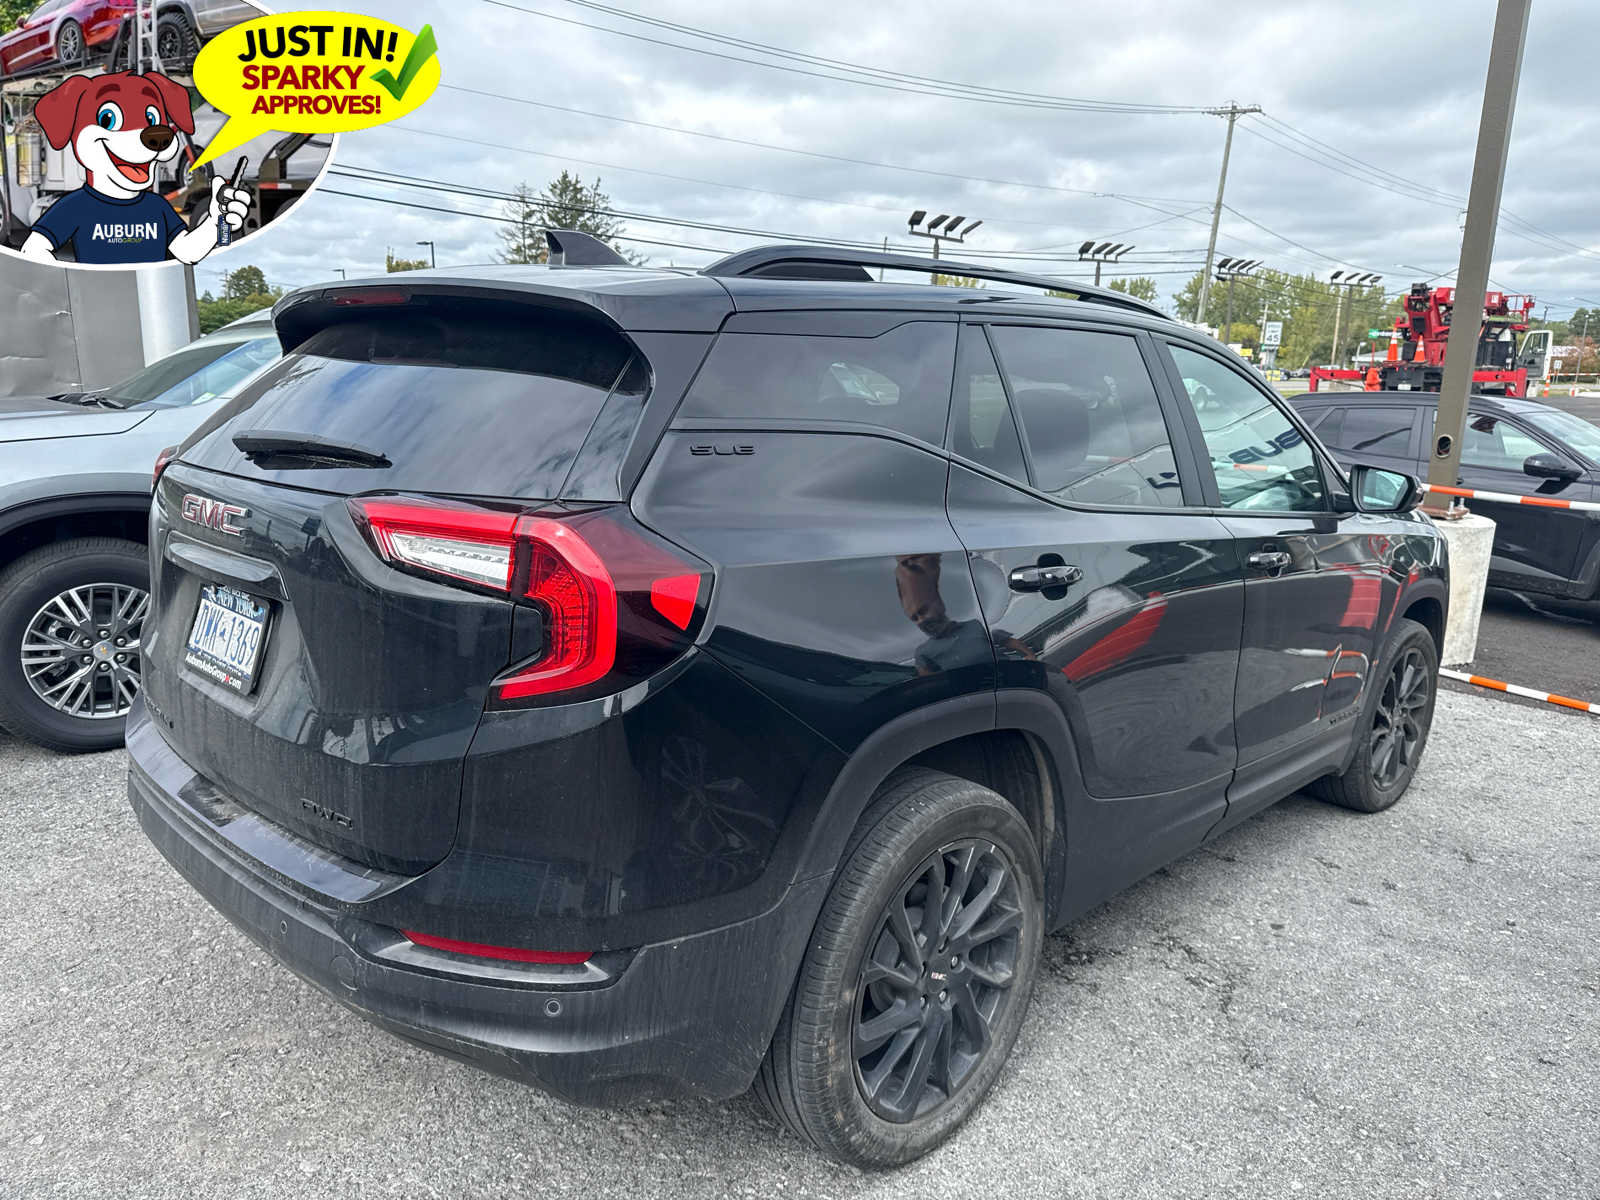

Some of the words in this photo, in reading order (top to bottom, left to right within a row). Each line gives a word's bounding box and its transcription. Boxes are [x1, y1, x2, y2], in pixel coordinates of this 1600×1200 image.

[1266, 334, 1279, 343] 45
[690, 446, 756, 456] SLE
[182, 493, 248, 537] GMC
